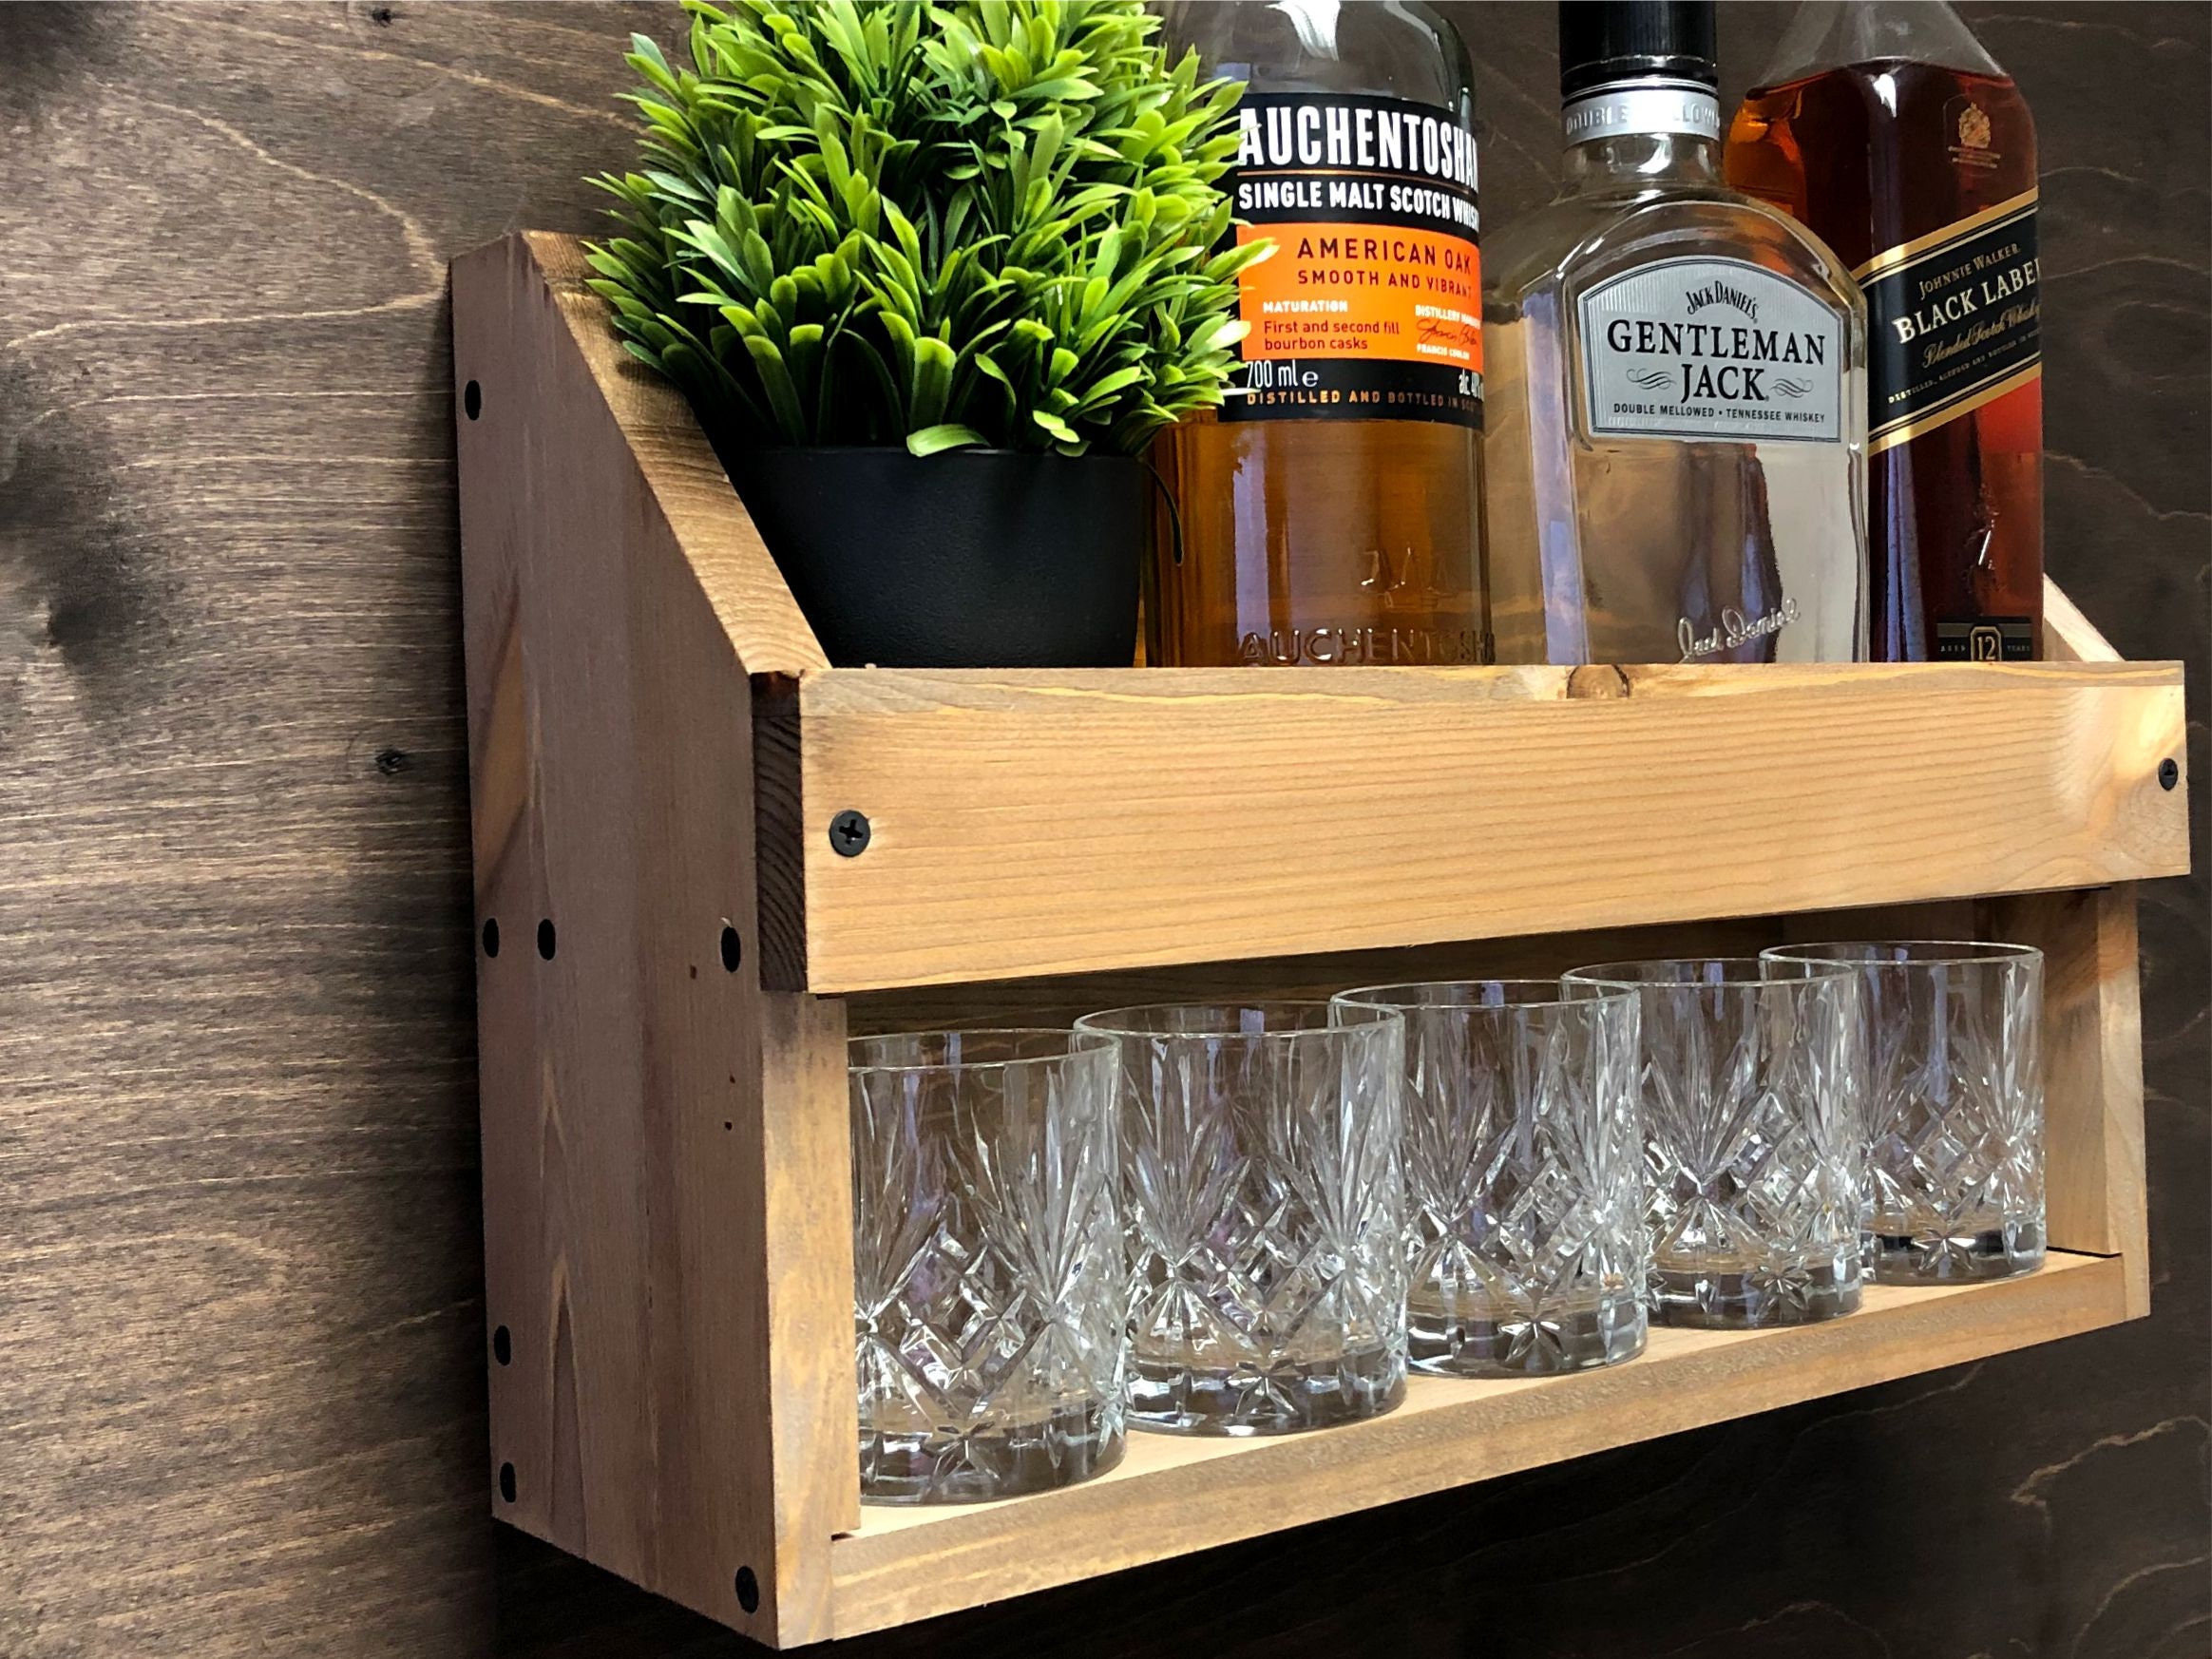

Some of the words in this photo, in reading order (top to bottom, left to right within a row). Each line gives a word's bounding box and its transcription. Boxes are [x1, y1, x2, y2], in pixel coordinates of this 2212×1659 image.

[1239, 181, 1322, 210] SINGLE
[1330, 181, 1382, 211] MALT
[1390, 189, 1450, 219] SCOTCH
[1297, 238, 1435, 266] AMERICAN
[1445, 249, 1471, 275] OAK
[1298, 270, 1378, 285] SMOOTH
[1388, 273, 1420, 289] AND
[1426, 276, 1471, 299] VIBRANT
[1919, 263, 1973, 300] JOHNNIE
[1973, 243, 2019, 271] WALKER
[1263, 300, 1347, 313] MATURATION
[1686, 286, 1714, 315] JACK
[1264, 321, 1297, 334] First
[1303, 320, 1328, 334] and
[1333, 321, 1379, 334] second
[1383, 321, 1400, 334] fill
[1891, 288, 1978, 344] BLACK
[1265, 337, 1325, 351] bourbon
[1330, 336, 1368, 350] casks
[1607, 319, 1825, 366] GENTLEMAN
[1922, 328, 1972, 369] Blended
[1247, 361, 1273, 389] 700
[1278, 359, 1298, 388] ml
[1680, 364, 1765, 404] JACK
[1247, 390, 1341, 405] DISTILLED
[1348, 390, 1381, 404] AND
[1388, 391, 1443, 407] BOTTLED
[1613, 403, 1655, 415] DOUBLE
[1660, 405, 1714, 417] MELLOWED
[1726, 409, 1781, 421] TENNESSEE
[1785, 411, 1825, 423] WHISKEY
[1977, 635, 1996, 660] 12
